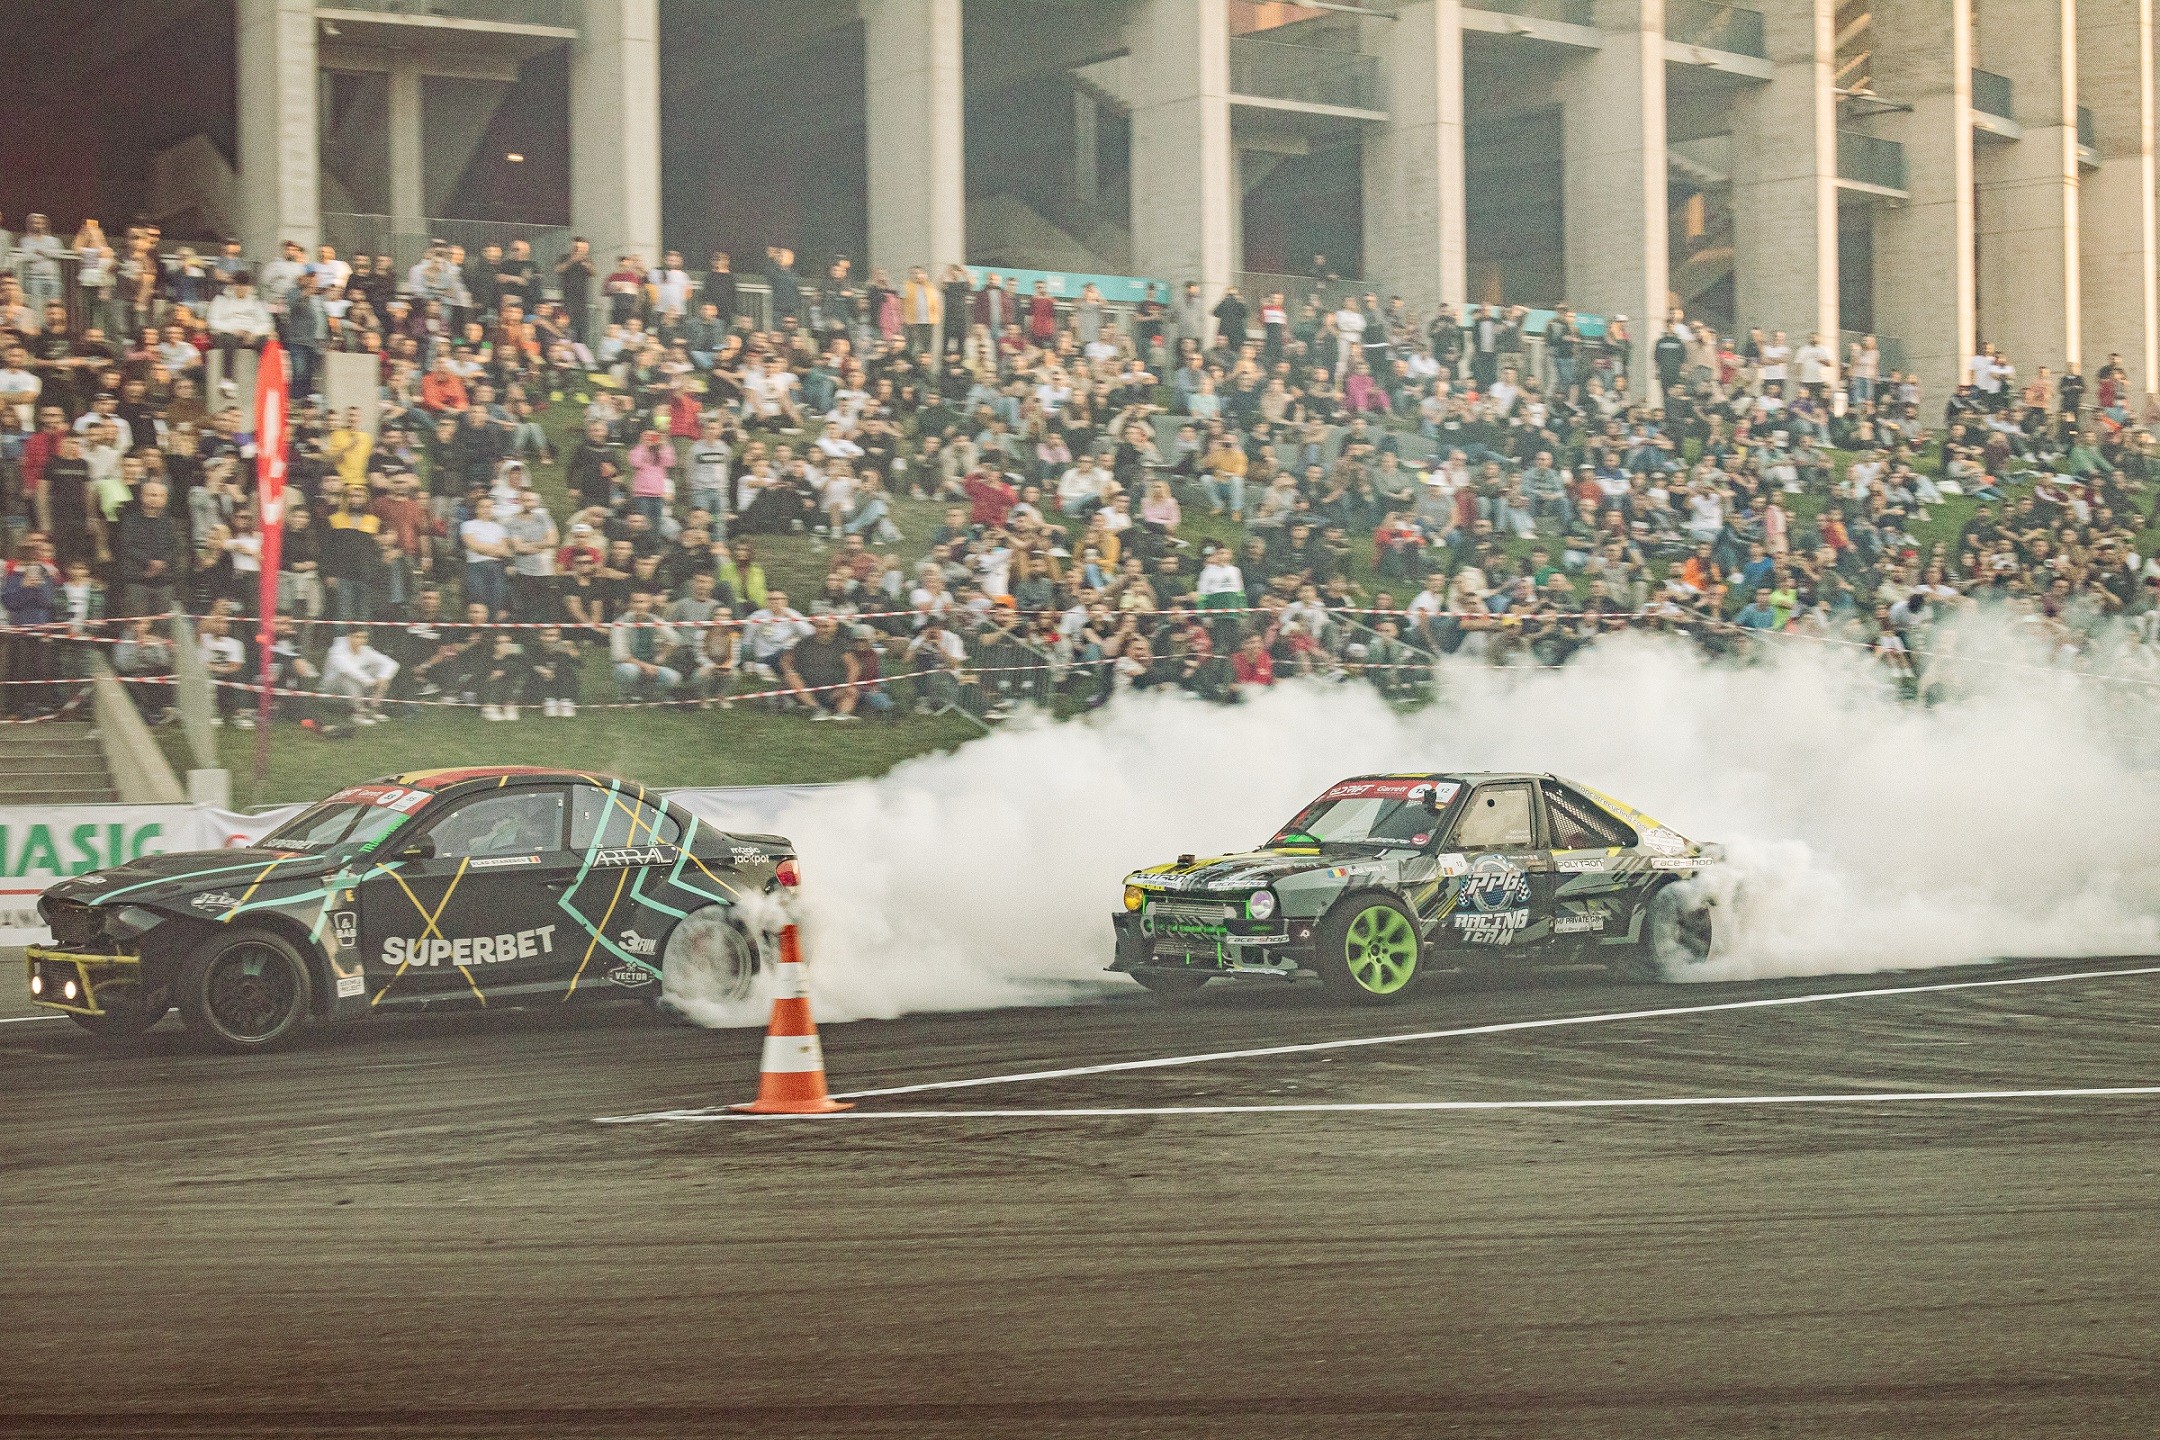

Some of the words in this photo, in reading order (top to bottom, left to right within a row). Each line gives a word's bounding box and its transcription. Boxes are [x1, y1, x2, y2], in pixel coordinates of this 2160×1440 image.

[733, 854, 770, 867] jackpot
[1465, 871, 1522, 896] PPG
[1453, 908, 1530, 930] RACING
[381, 924, 556, 967] SUPERBET
[1463, 927, 1515, 947] TEAM
[615, 972, 648, 981] VECTOR
